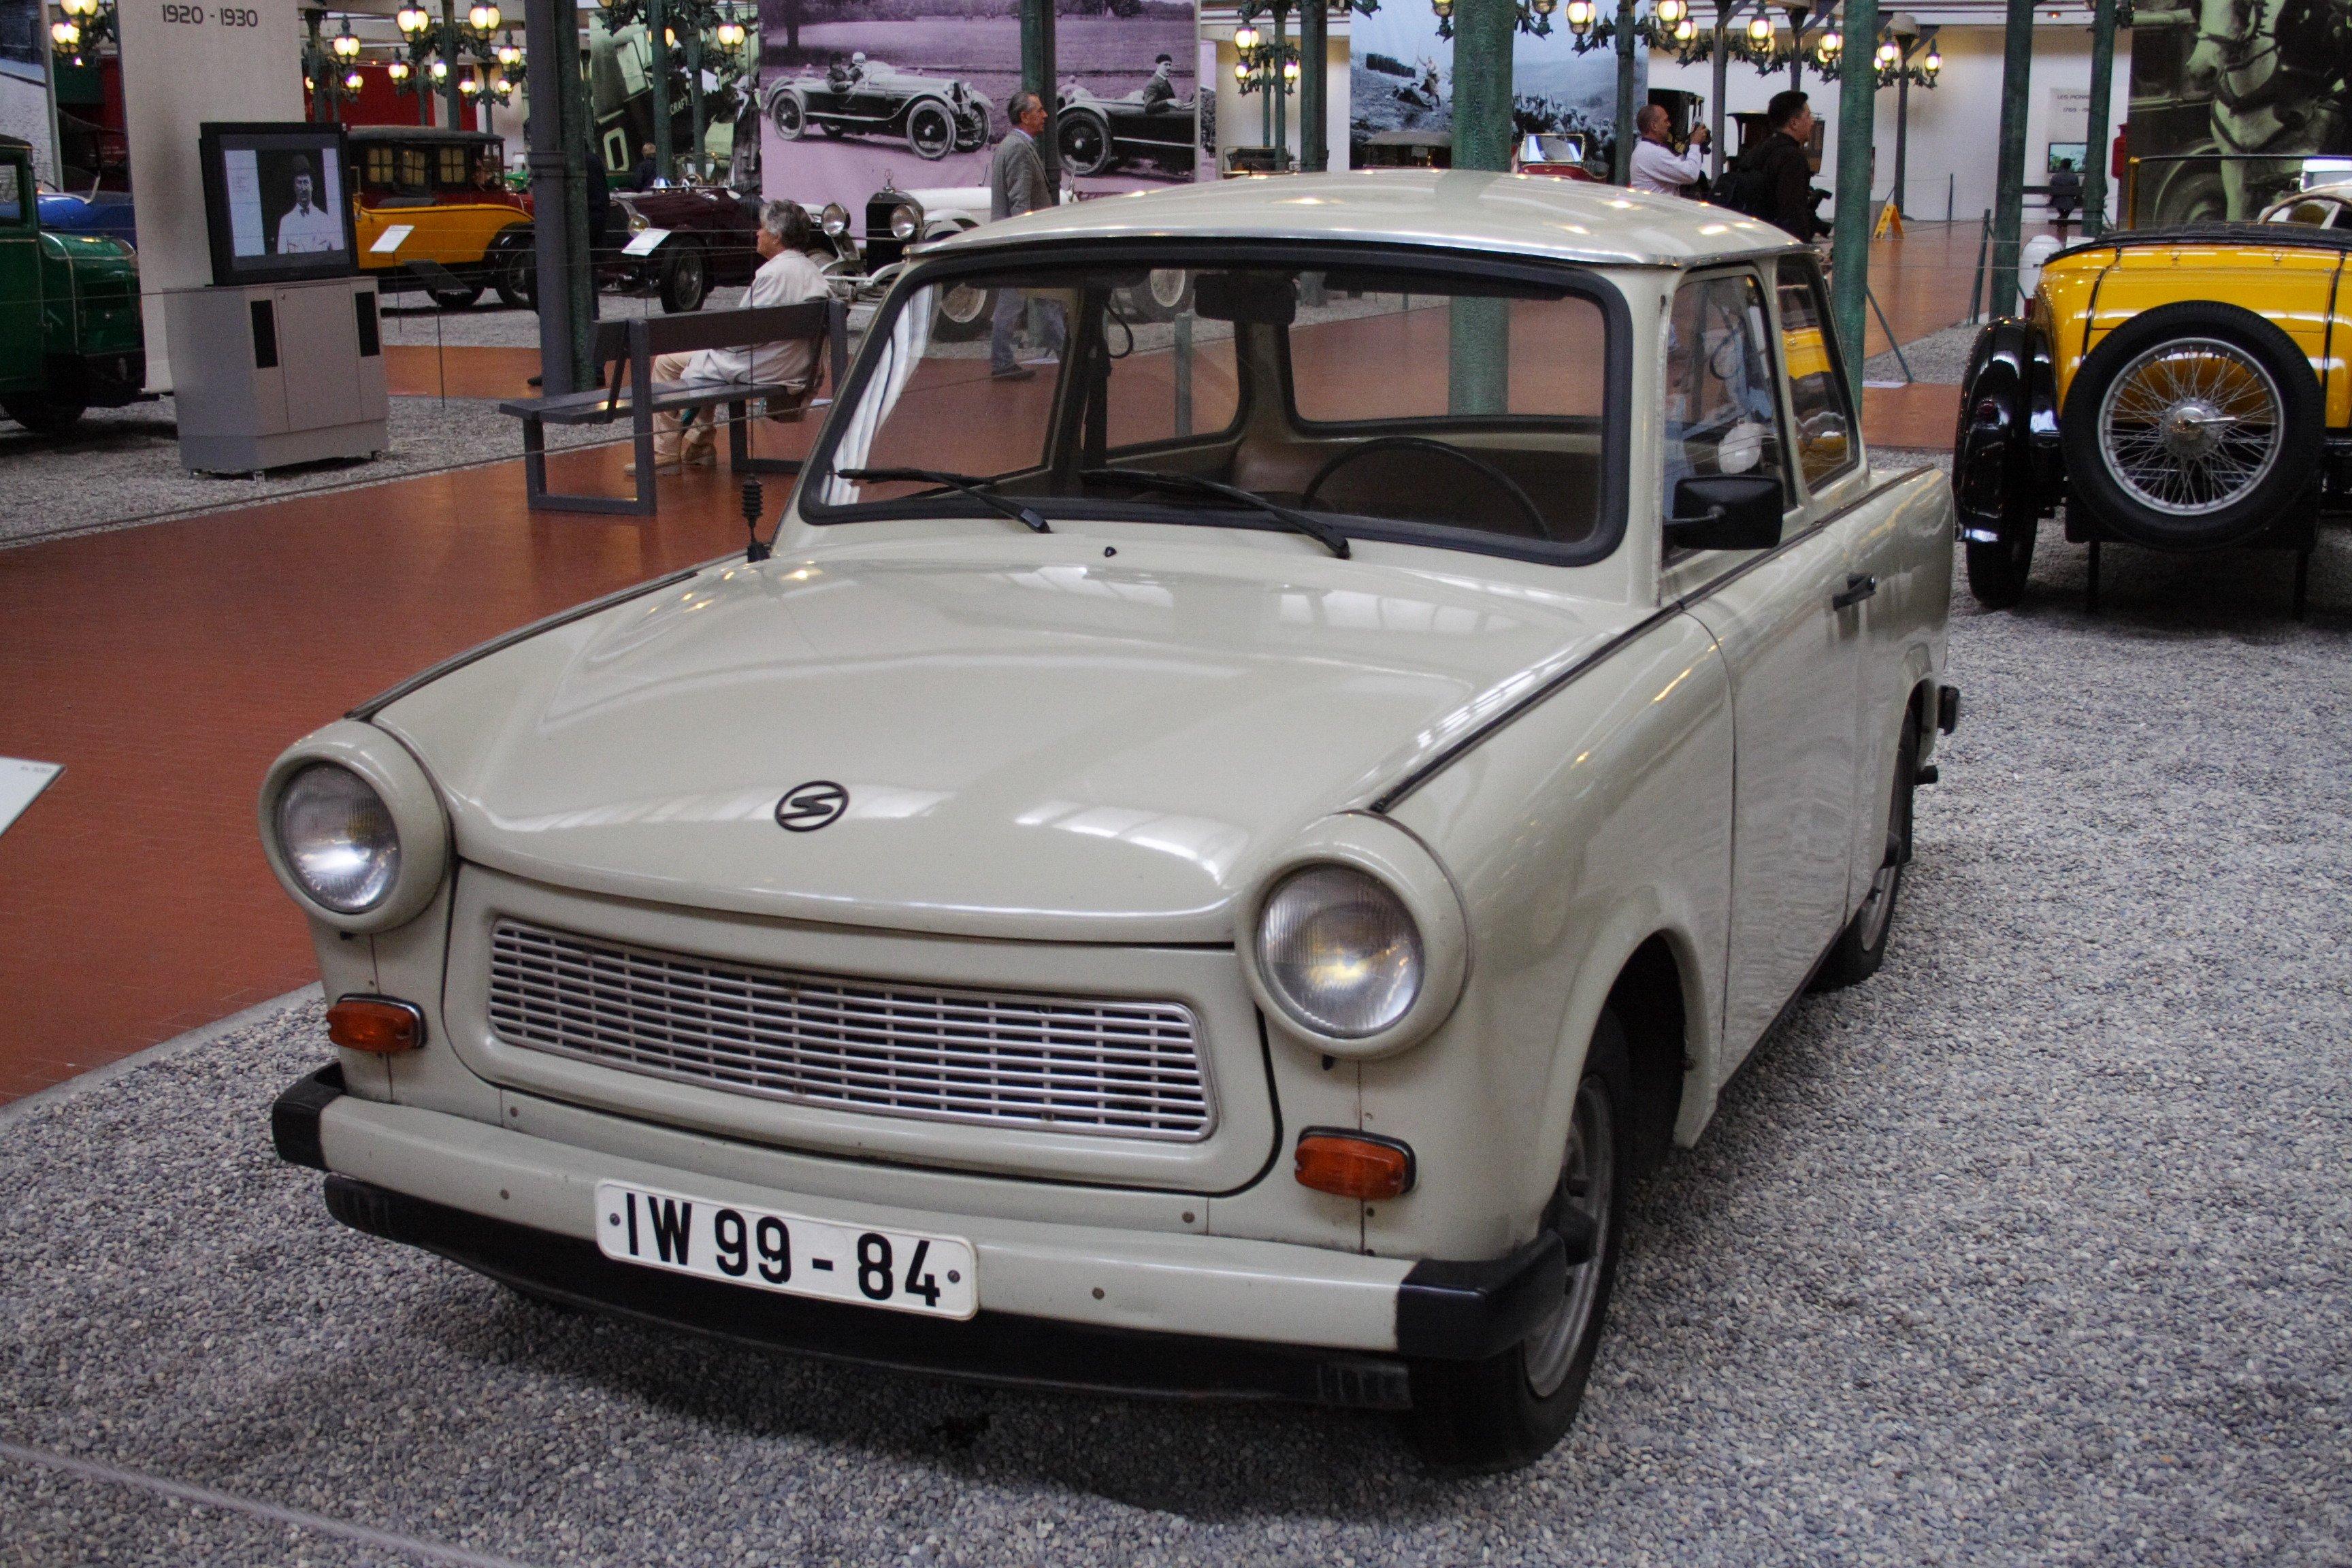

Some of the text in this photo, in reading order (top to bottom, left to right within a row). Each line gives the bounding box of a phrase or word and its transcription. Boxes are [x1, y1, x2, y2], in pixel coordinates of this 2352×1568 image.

[163, 4, 203, 24] 1920
[220, 7, 258, 27] 1930
[626, 1193, 692, 1266] IW
[715, 1209, 791, 1284] 99
[857, 1232, 941, 1307] 84
